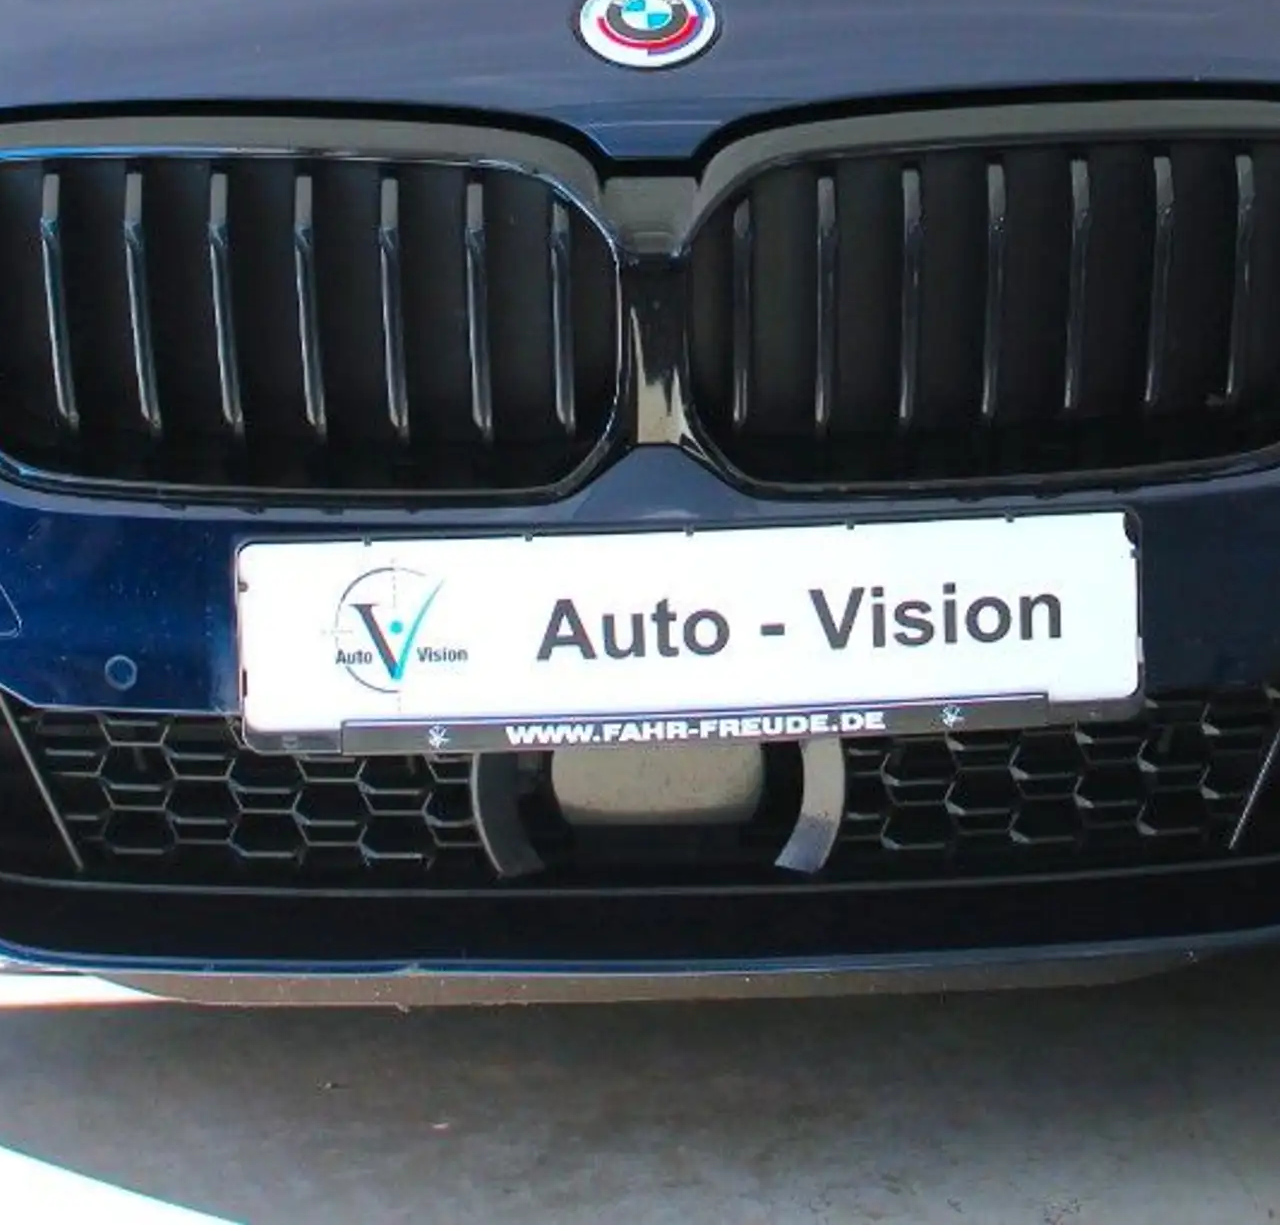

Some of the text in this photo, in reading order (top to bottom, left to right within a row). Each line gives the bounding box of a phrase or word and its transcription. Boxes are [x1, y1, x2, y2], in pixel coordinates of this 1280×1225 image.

[535, 597, 731, 662] Auto
[807, 581, 1063, 651] Vision
[335, 645, 469, 665] Auto Vision
[506, 711, 887, 745] WWW.FAHR-FREUDE.DE
